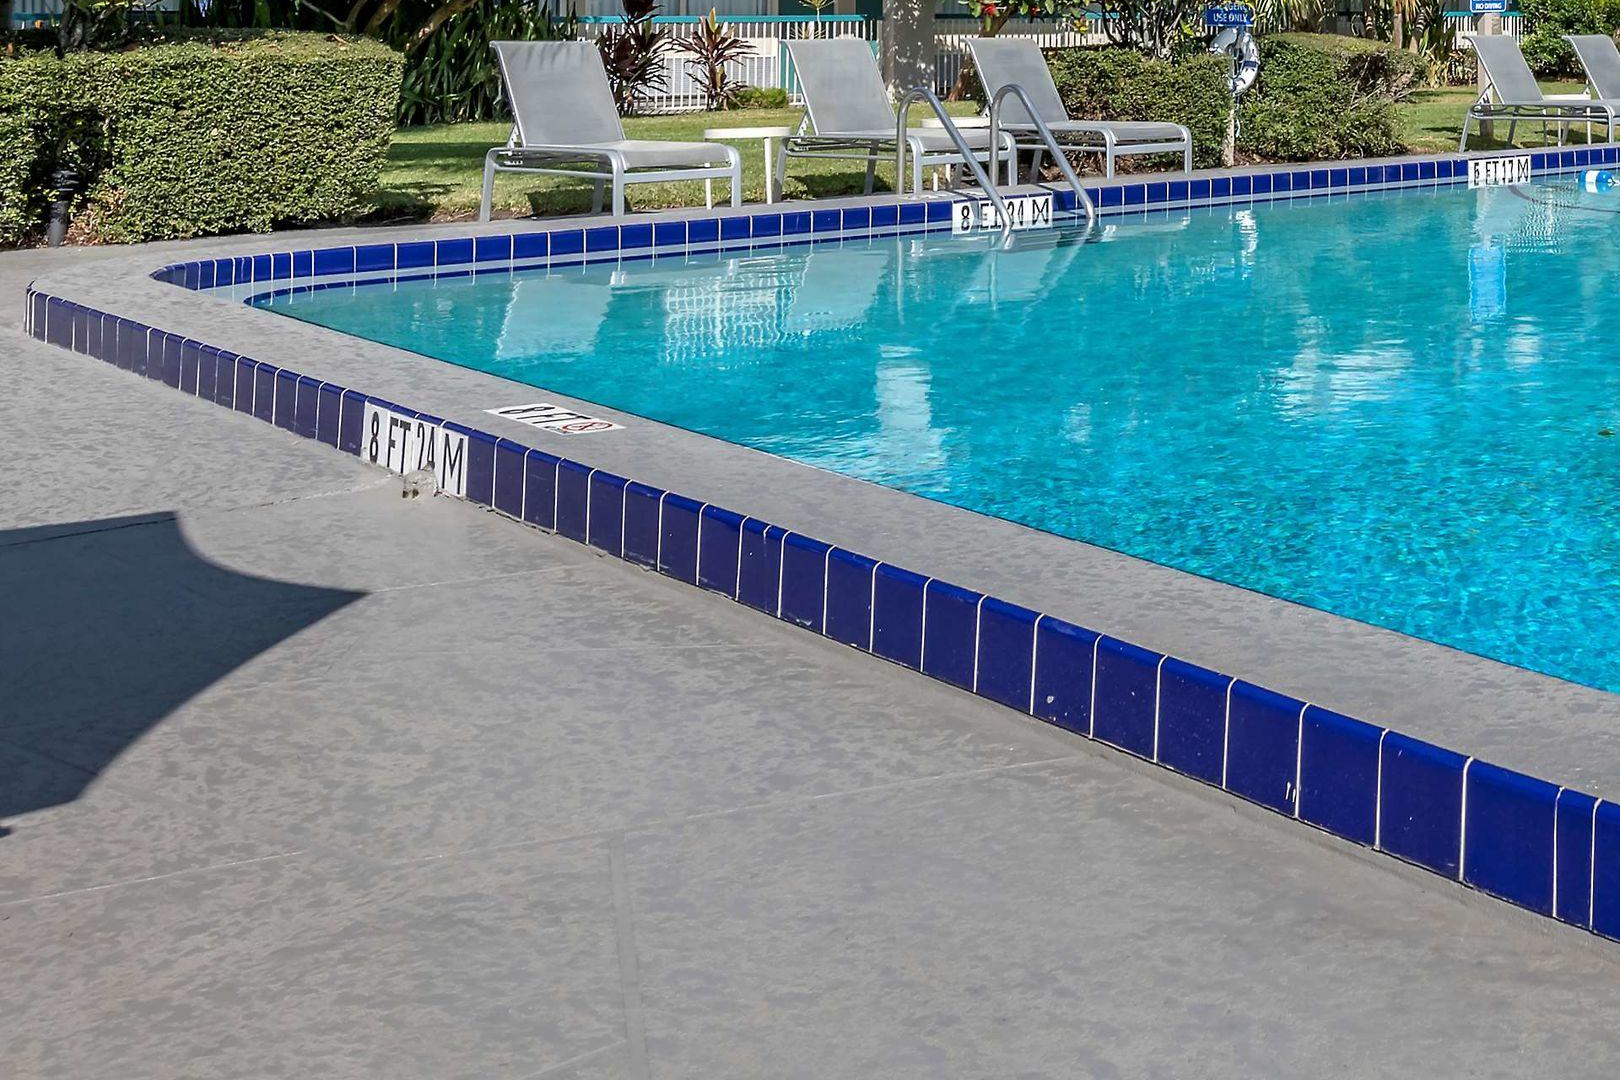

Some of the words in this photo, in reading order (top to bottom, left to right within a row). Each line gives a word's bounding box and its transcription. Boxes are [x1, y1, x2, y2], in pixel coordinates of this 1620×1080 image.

[1213, 12, 1228, 22] USE
[1228, 12, 1248, 22] ONLY
[1032, 198, 1049, 221] M
[498, 406, 556, 415] 8
[516, 412, 592, 424] FT
[369, 411, 380, 465] 8
[387, 416, 411, 474] FT
[442, 433, 464, 495] M
